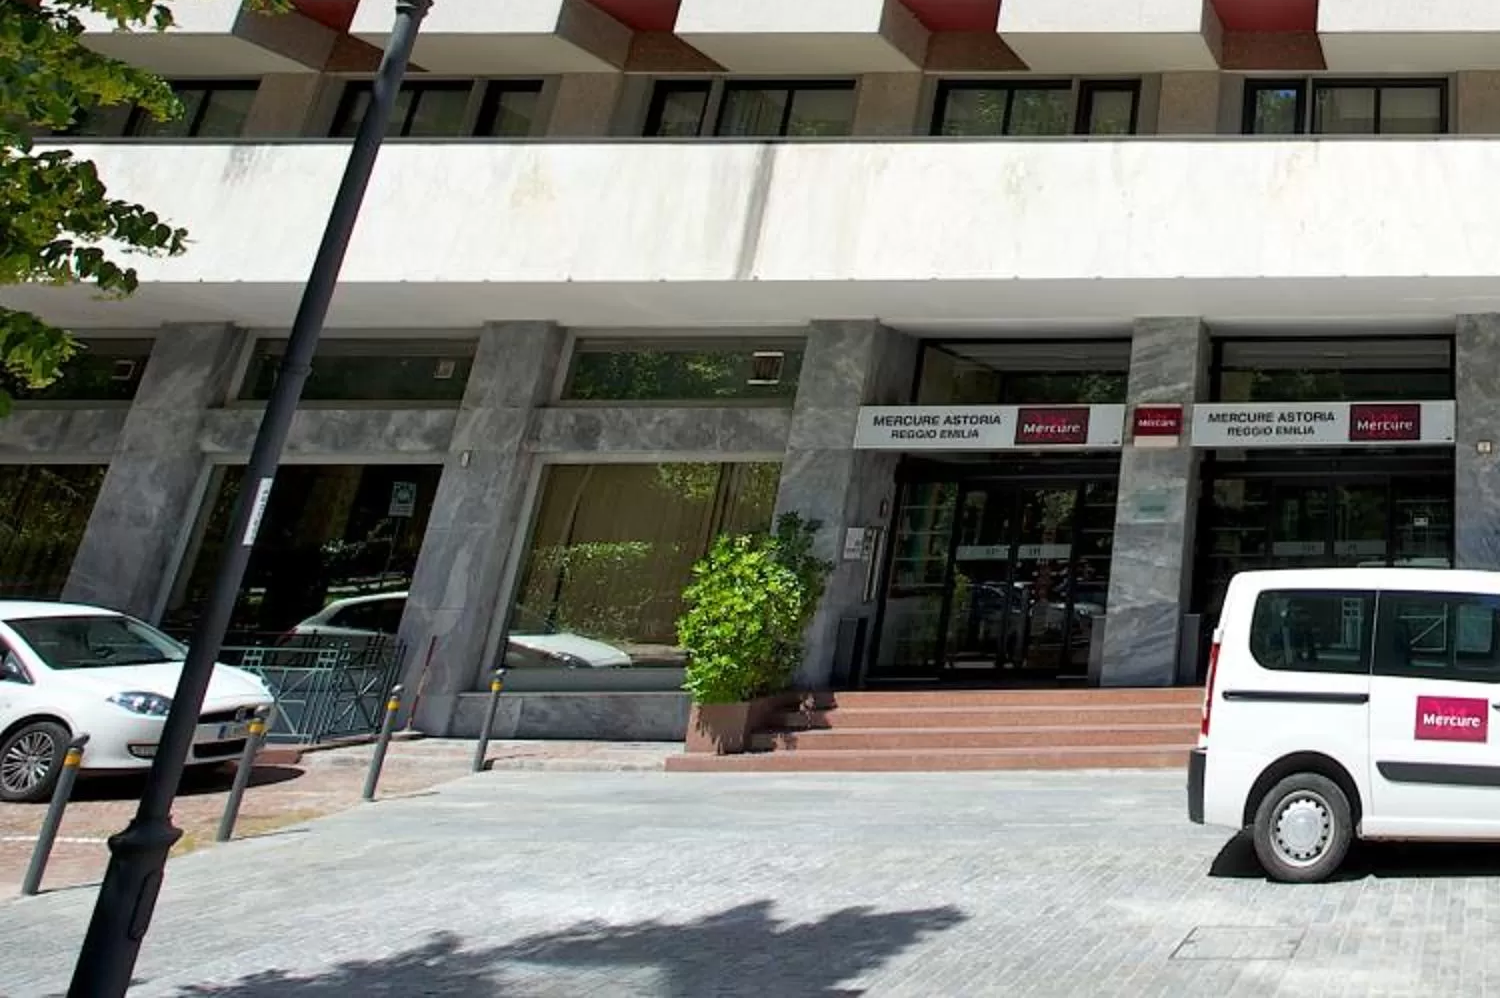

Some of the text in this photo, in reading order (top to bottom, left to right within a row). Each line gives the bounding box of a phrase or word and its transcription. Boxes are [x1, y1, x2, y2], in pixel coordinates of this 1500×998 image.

[873, 413, 1002, 427] MERCURE ASTORIA
[1138, 417, 1176, 428] Mercure
[1207, 411, 1335, 424] MERCURE ASTORIA
[1023, 422, 1082, 434] Mercure
[1357, 418, 1414, 431] Mercure
[891, 429, 980, 440] REGGIO EMILIA
[1227, 425, 1315, 437] REGGIO EMILIA
[1423, 713, 1481, 728] Mercure
